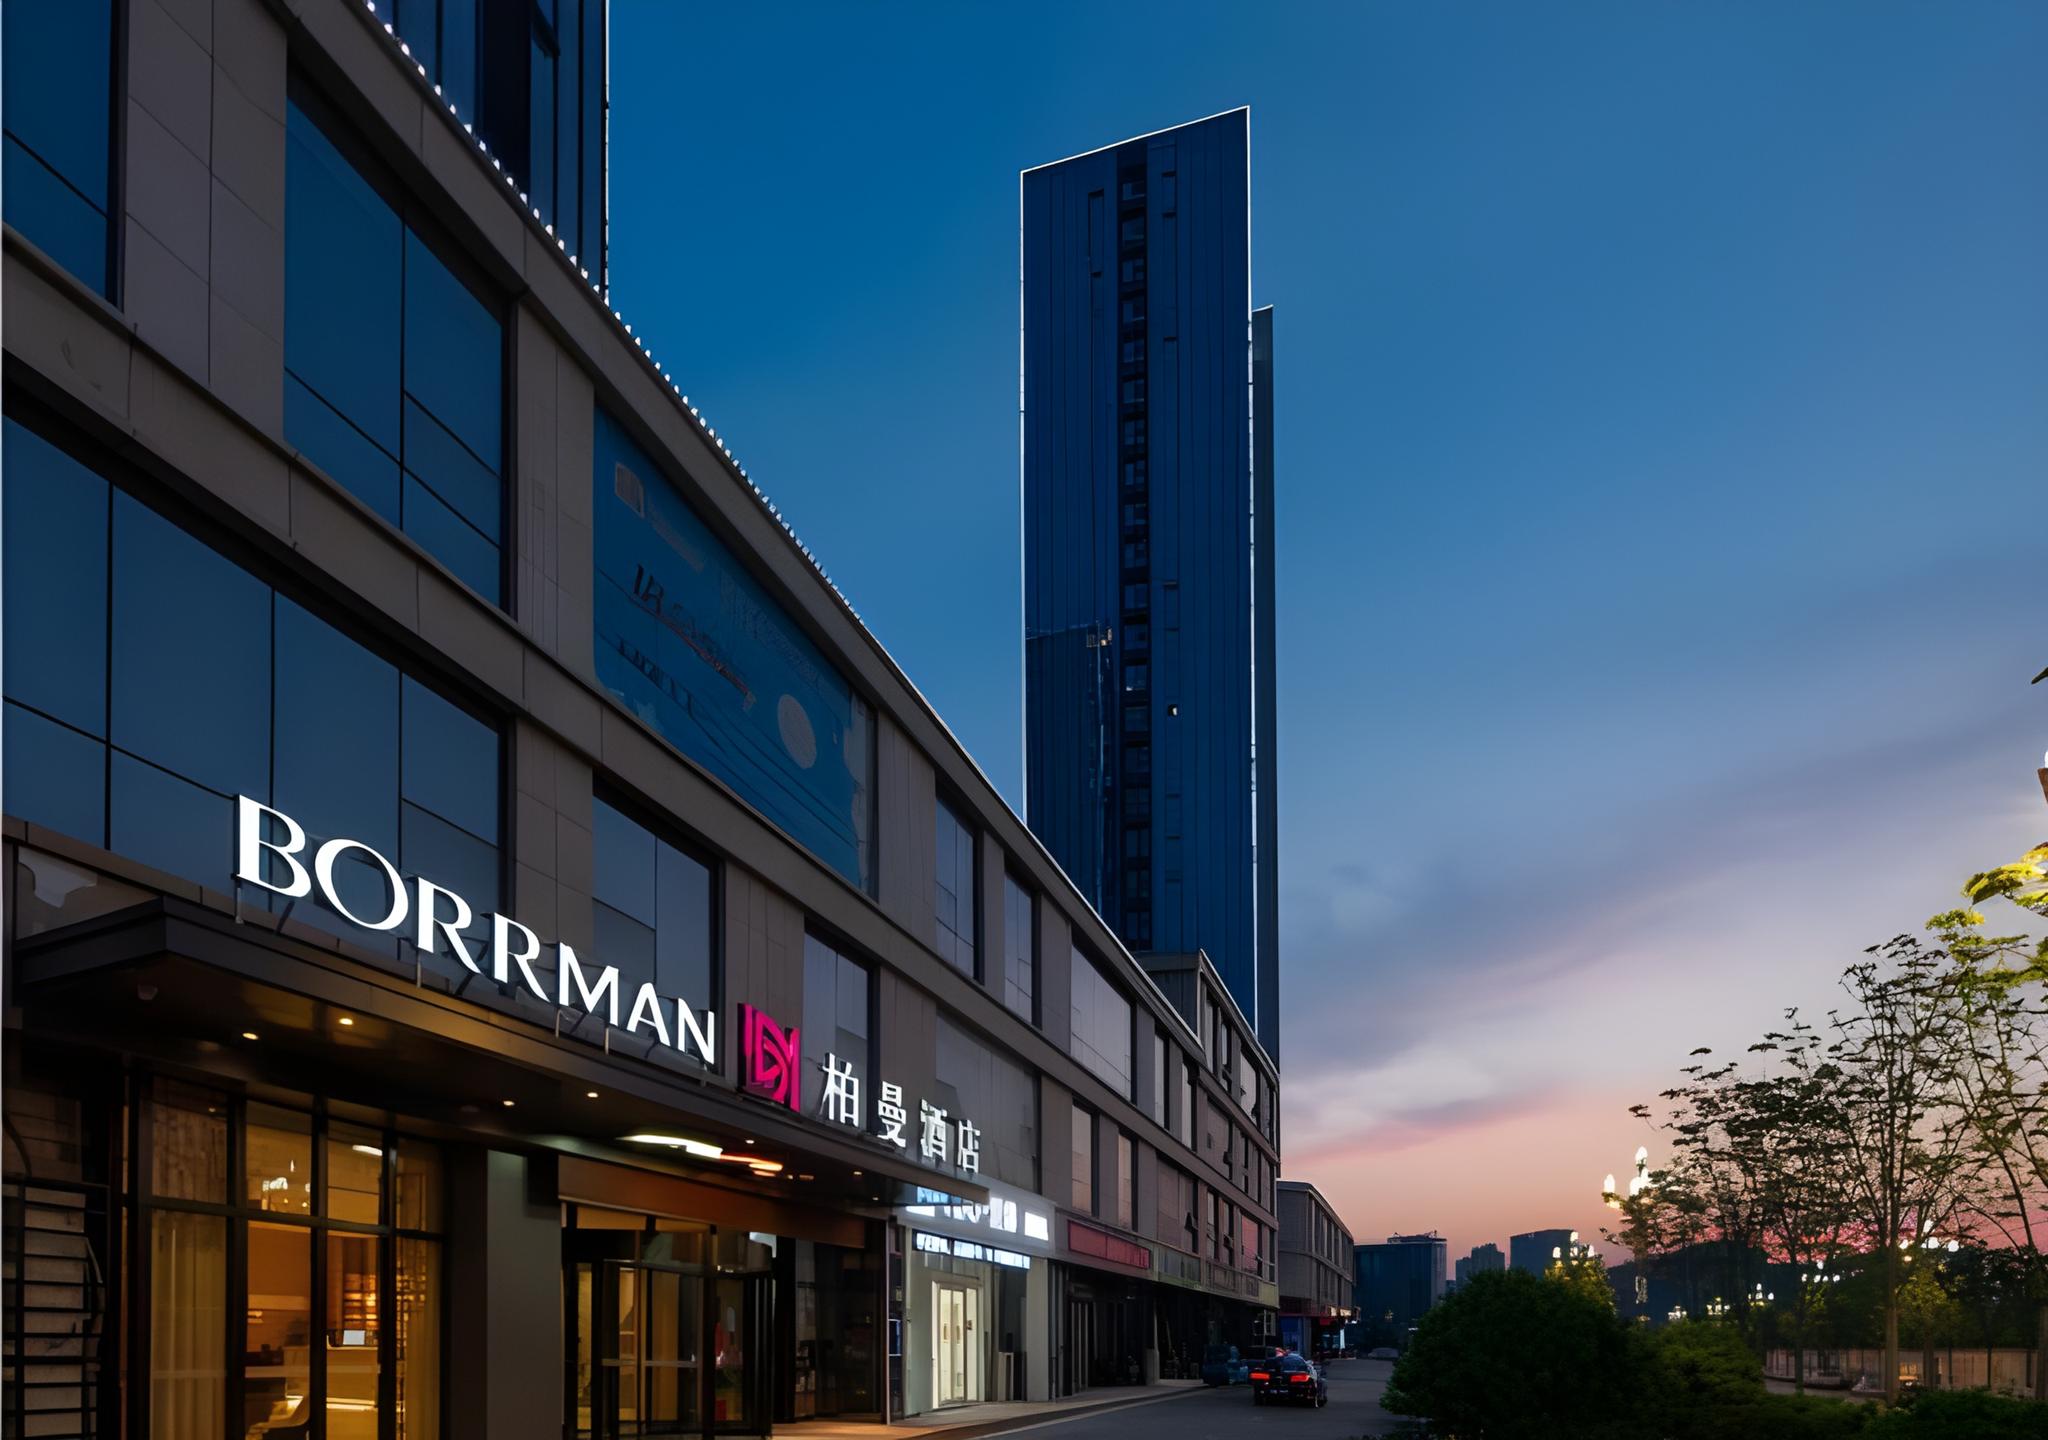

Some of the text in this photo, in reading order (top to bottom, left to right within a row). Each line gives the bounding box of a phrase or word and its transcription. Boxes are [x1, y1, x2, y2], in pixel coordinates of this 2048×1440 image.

[237, 794, 716, 1065] BORRMAN
[820, 1052, 981, 1174] 柏曼酒店
